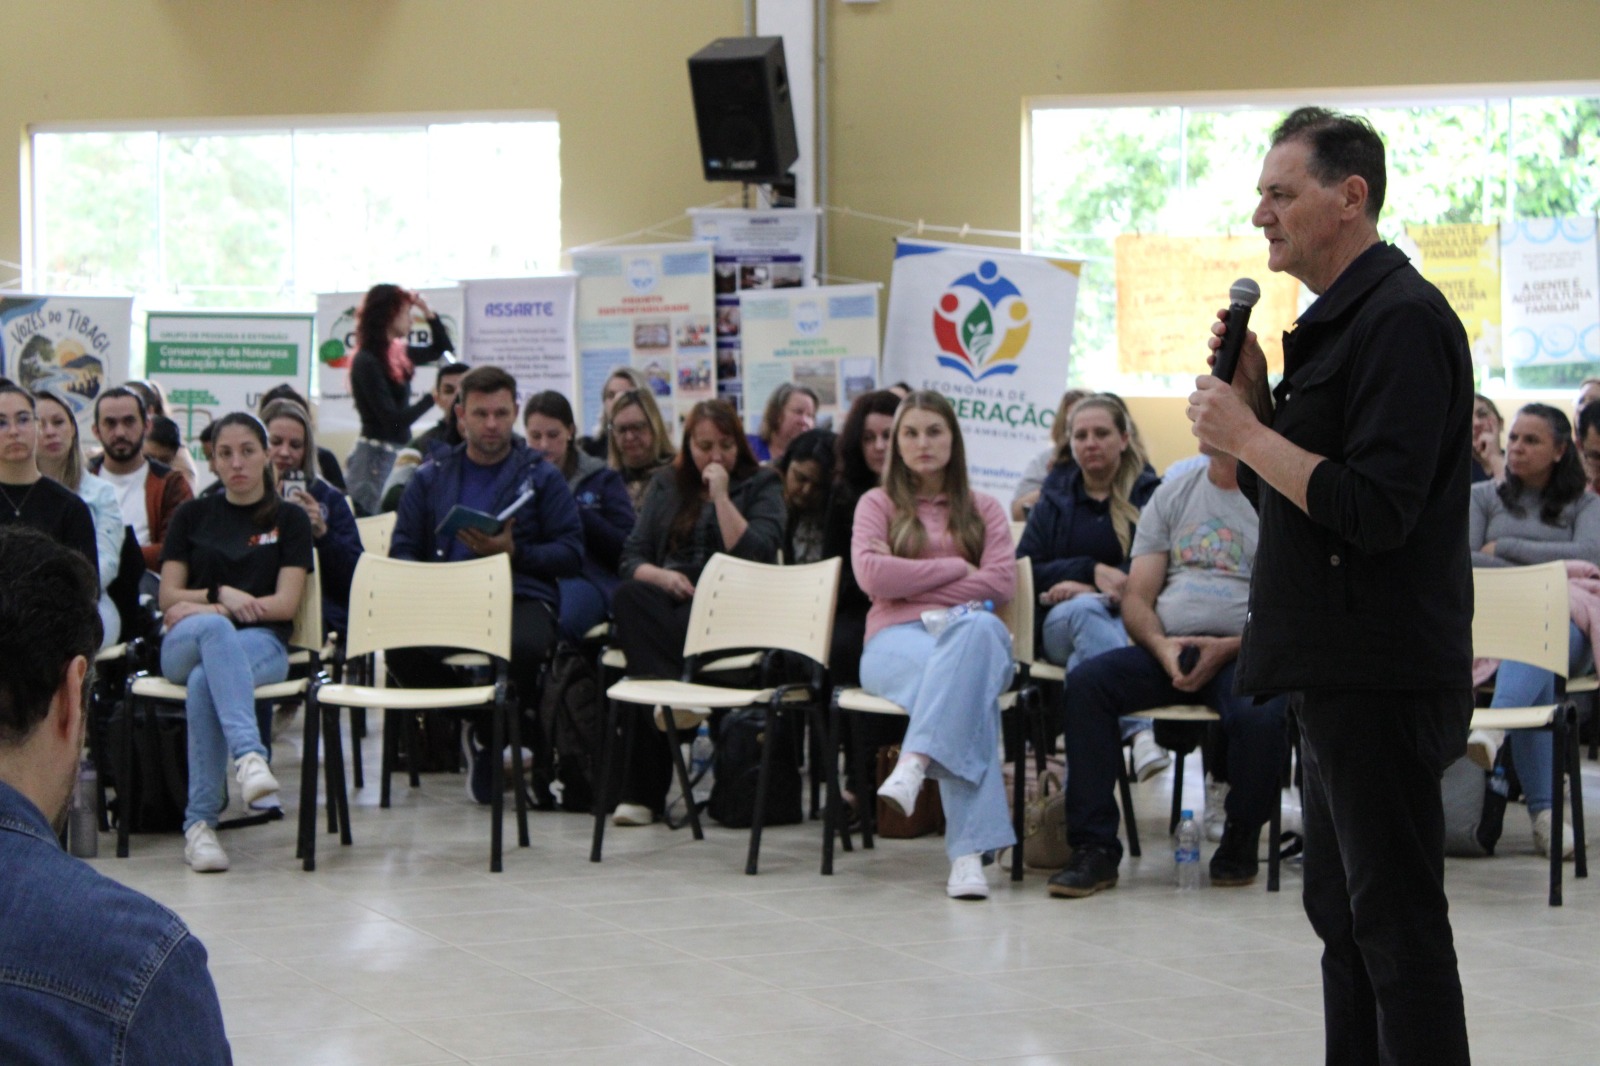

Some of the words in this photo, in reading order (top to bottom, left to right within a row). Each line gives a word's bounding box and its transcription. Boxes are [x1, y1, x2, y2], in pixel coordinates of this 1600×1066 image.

[1532, 279, 1569, 290] GENTE
[1512, 288, 1592, 304] AGRICULTURA
[485, 301, 554, 317] ASSARTE
[1525, 302, 1580, 314] FAMILIAR
[11, 308, 46, 344] VOZES
[48, 310, 62, 324] DO
[67, 308, 110, 352] TIBAGI
[160, 345, 225, 359] Conservação
[226, 347, 240, 358] da
[242, 347, 288, 359] Natureza
[168, 358, 217, 371] Educação
[219, 359, 272, 370] Ambiental
[922, 380, 1004, 400] ECONOMIA
[1008, 390, 1027, 401] DE
[974, 427, 1037, 442] AMBIENTAL
